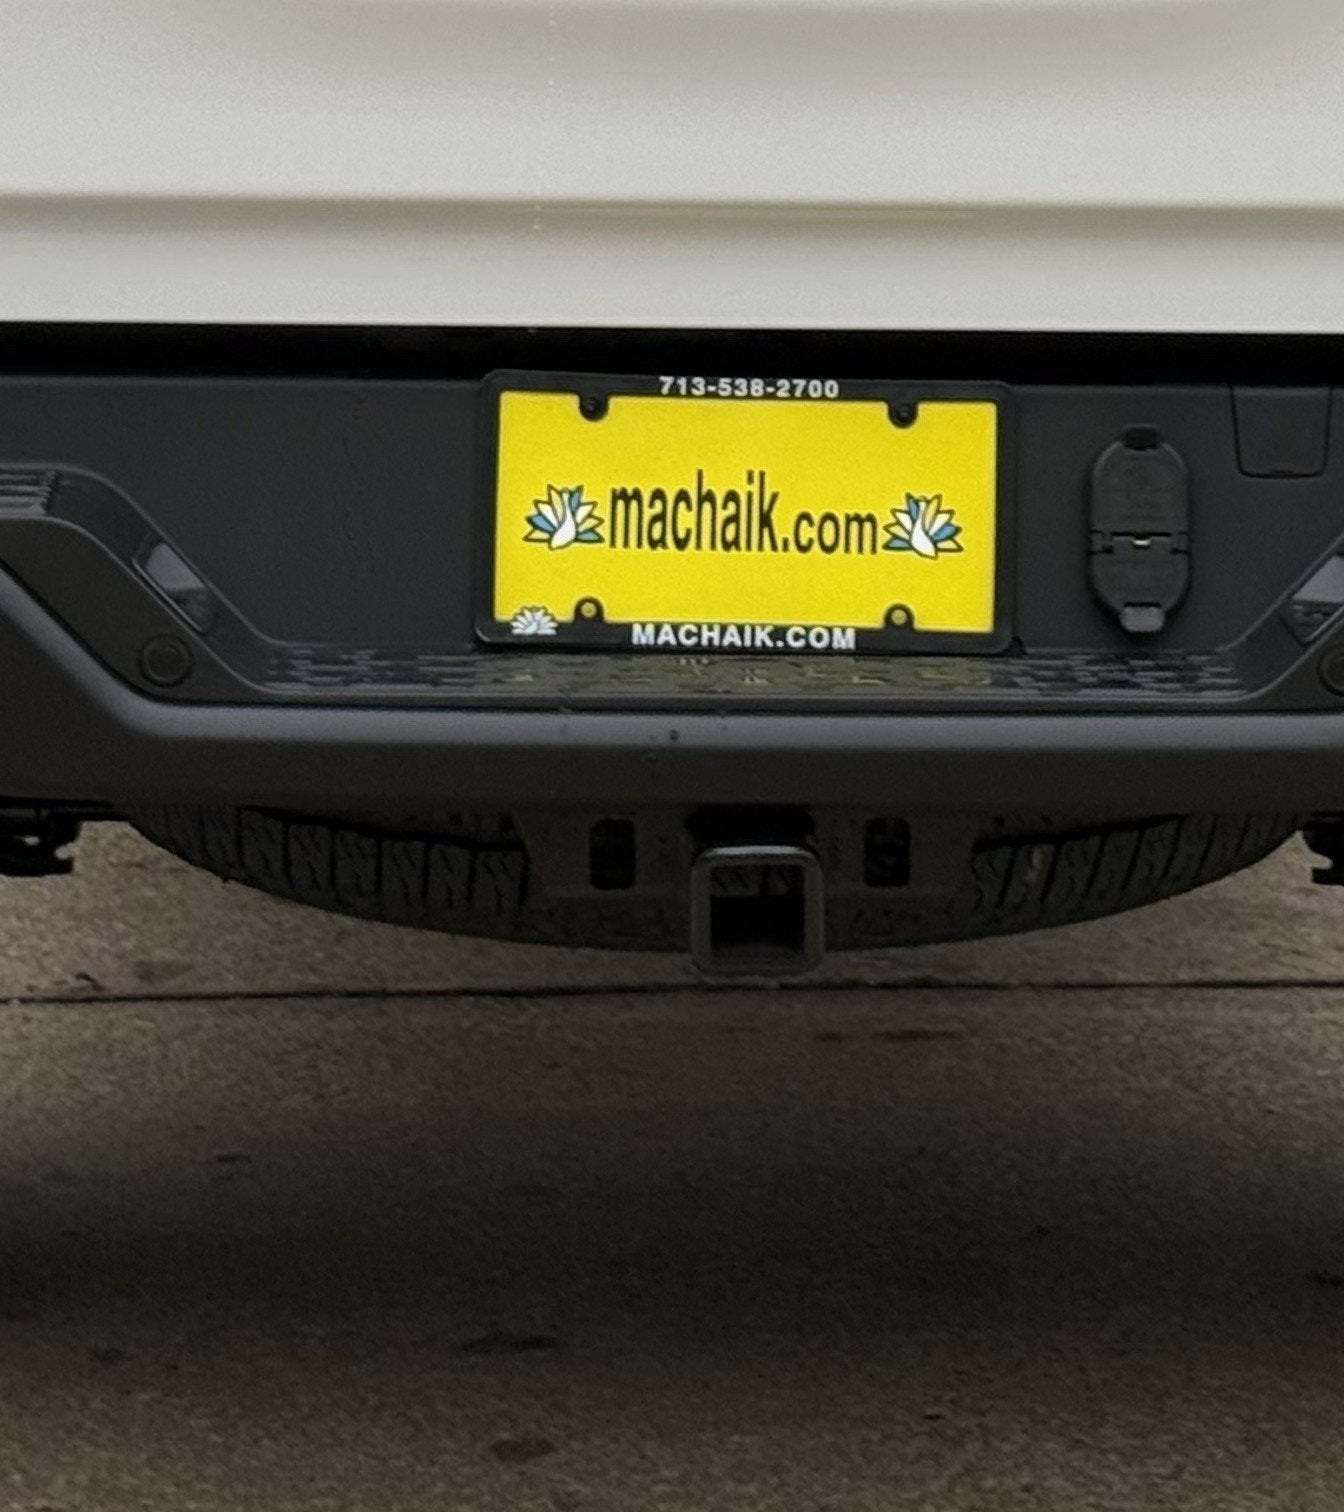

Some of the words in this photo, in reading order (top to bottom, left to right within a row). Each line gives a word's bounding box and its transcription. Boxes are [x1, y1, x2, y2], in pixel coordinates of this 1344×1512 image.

[658, 375, 840, 399] 713-538-2700
[608, 468, 879, 555] machaik.com
[630, 622, 857, 651] MACHAIK.COM
